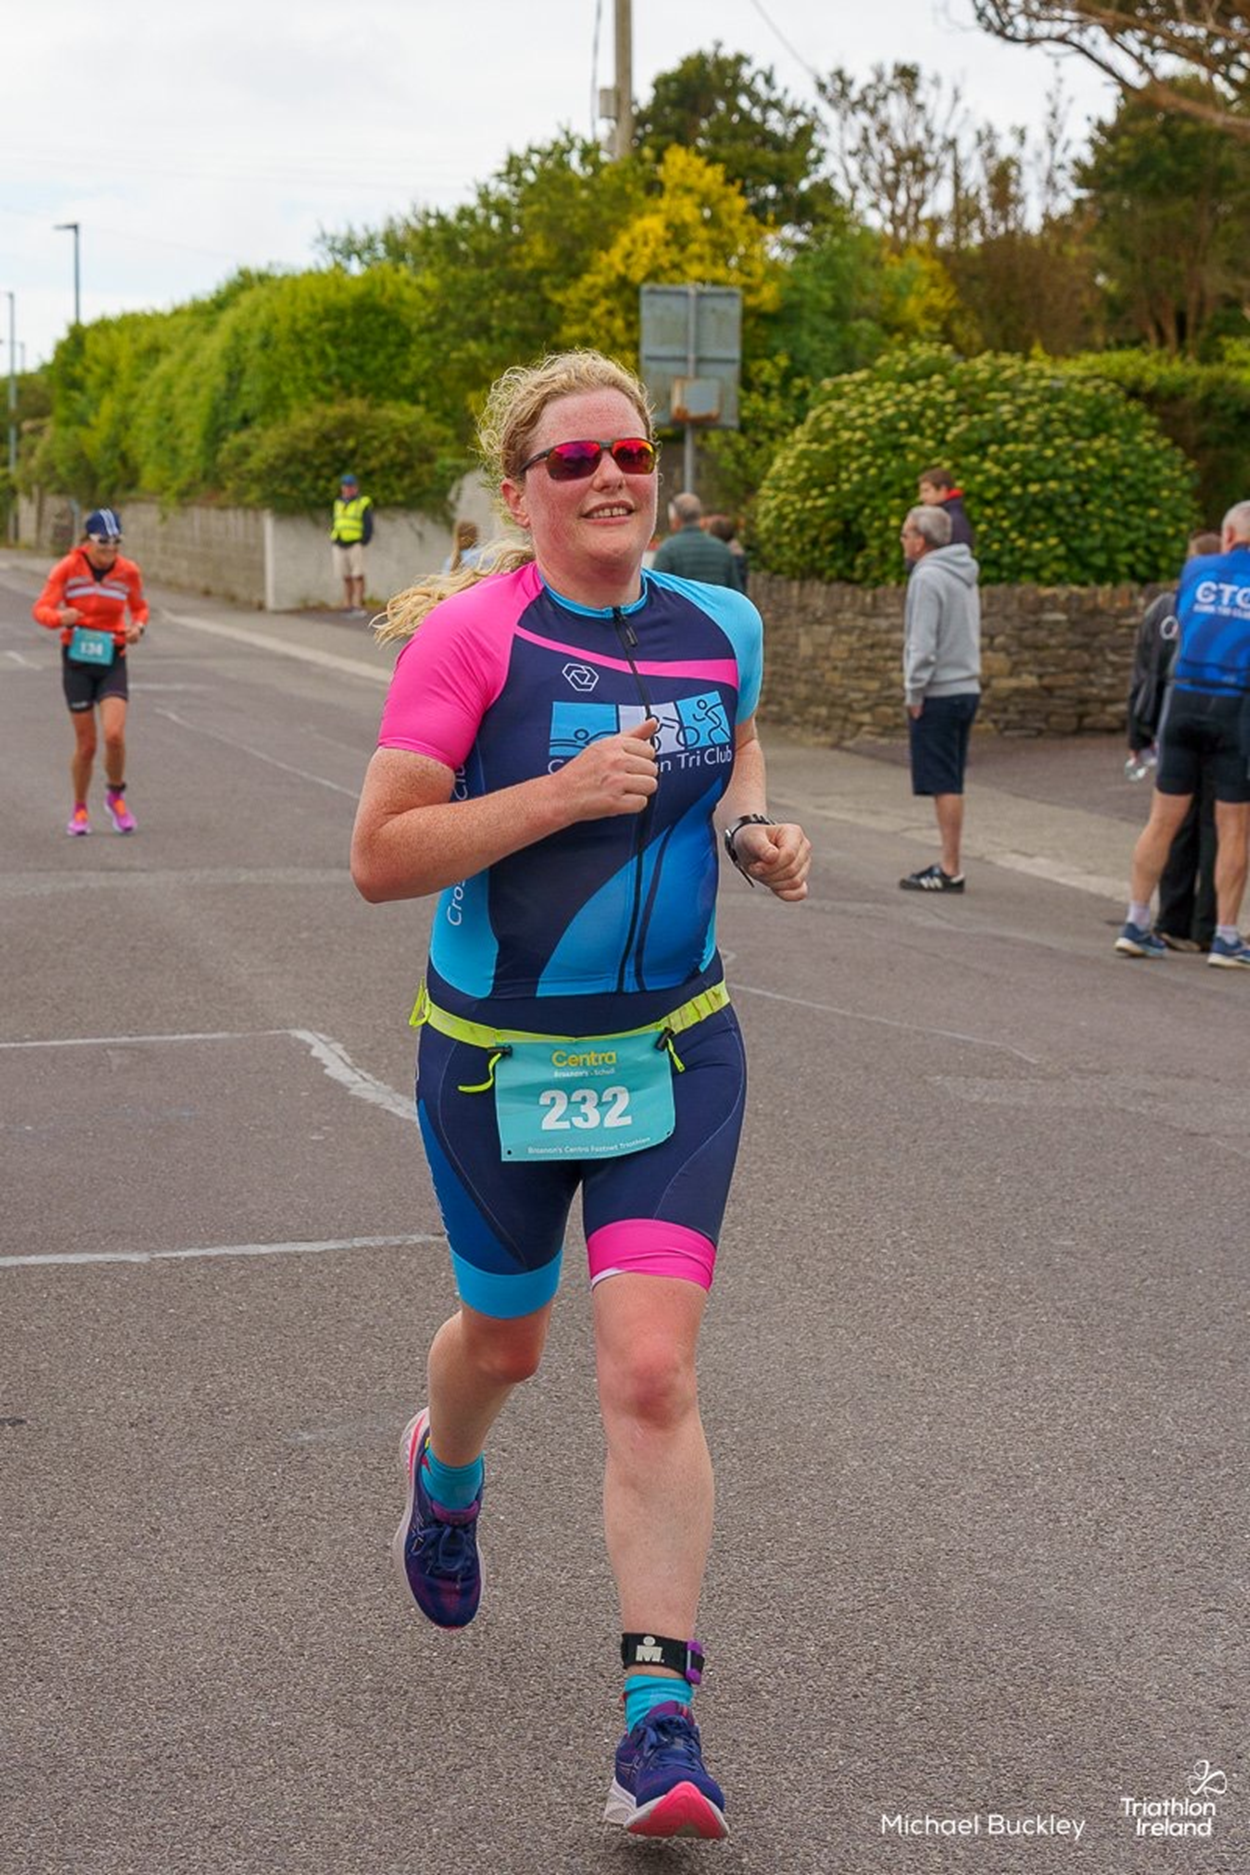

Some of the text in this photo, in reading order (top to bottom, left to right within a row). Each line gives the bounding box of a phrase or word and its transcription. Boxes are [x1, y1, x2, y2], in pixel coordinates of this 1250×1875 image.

[676, 752, 701, 769] Tri
[704, 743, 733, 765] Club
[551, 1050, 617, 1067] Centra
[539, 1085, 633, 1130] 232
